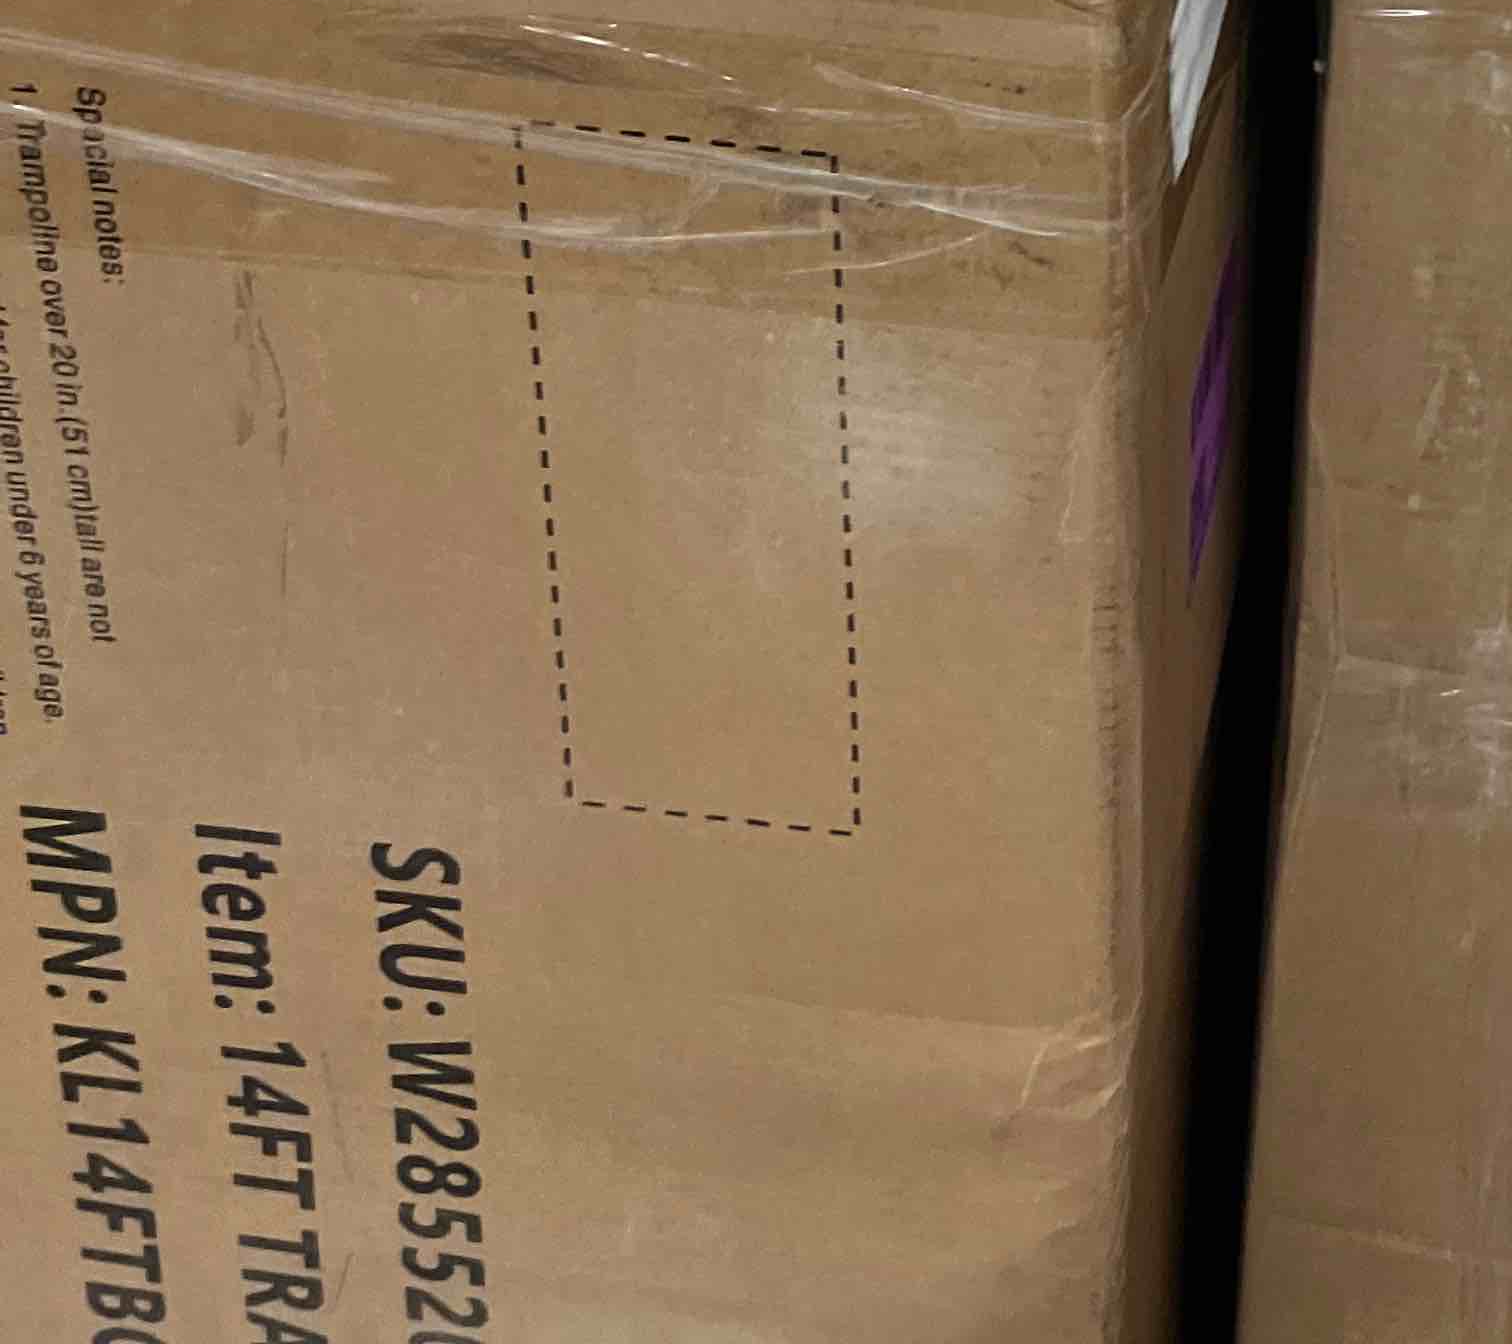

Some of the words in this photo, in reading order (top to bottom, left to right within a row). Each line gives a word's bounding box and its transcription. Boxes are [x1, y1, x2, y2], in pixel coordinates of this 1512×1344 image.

[17, 119, 60, 273] Trampoline
[92, 198, 124, 286] notes:
[39, 279, 69, 340] over
[48, 343, 80, 378] 20
[6, 471, 38, 545] under
[18, 550, 46, 565] 6
[81, 556, 107, 599] are
[14, 570, 52, 640] years
[88, 602, 118, 643] not
[34, 644, 64, 670] of
[19, 804, 128, 1006] MPN:
[194, 822, 282, 1015] Item:
[370, 841, 469, 1017] SKU:
[220, 1041, 316, 1212] 14FT
